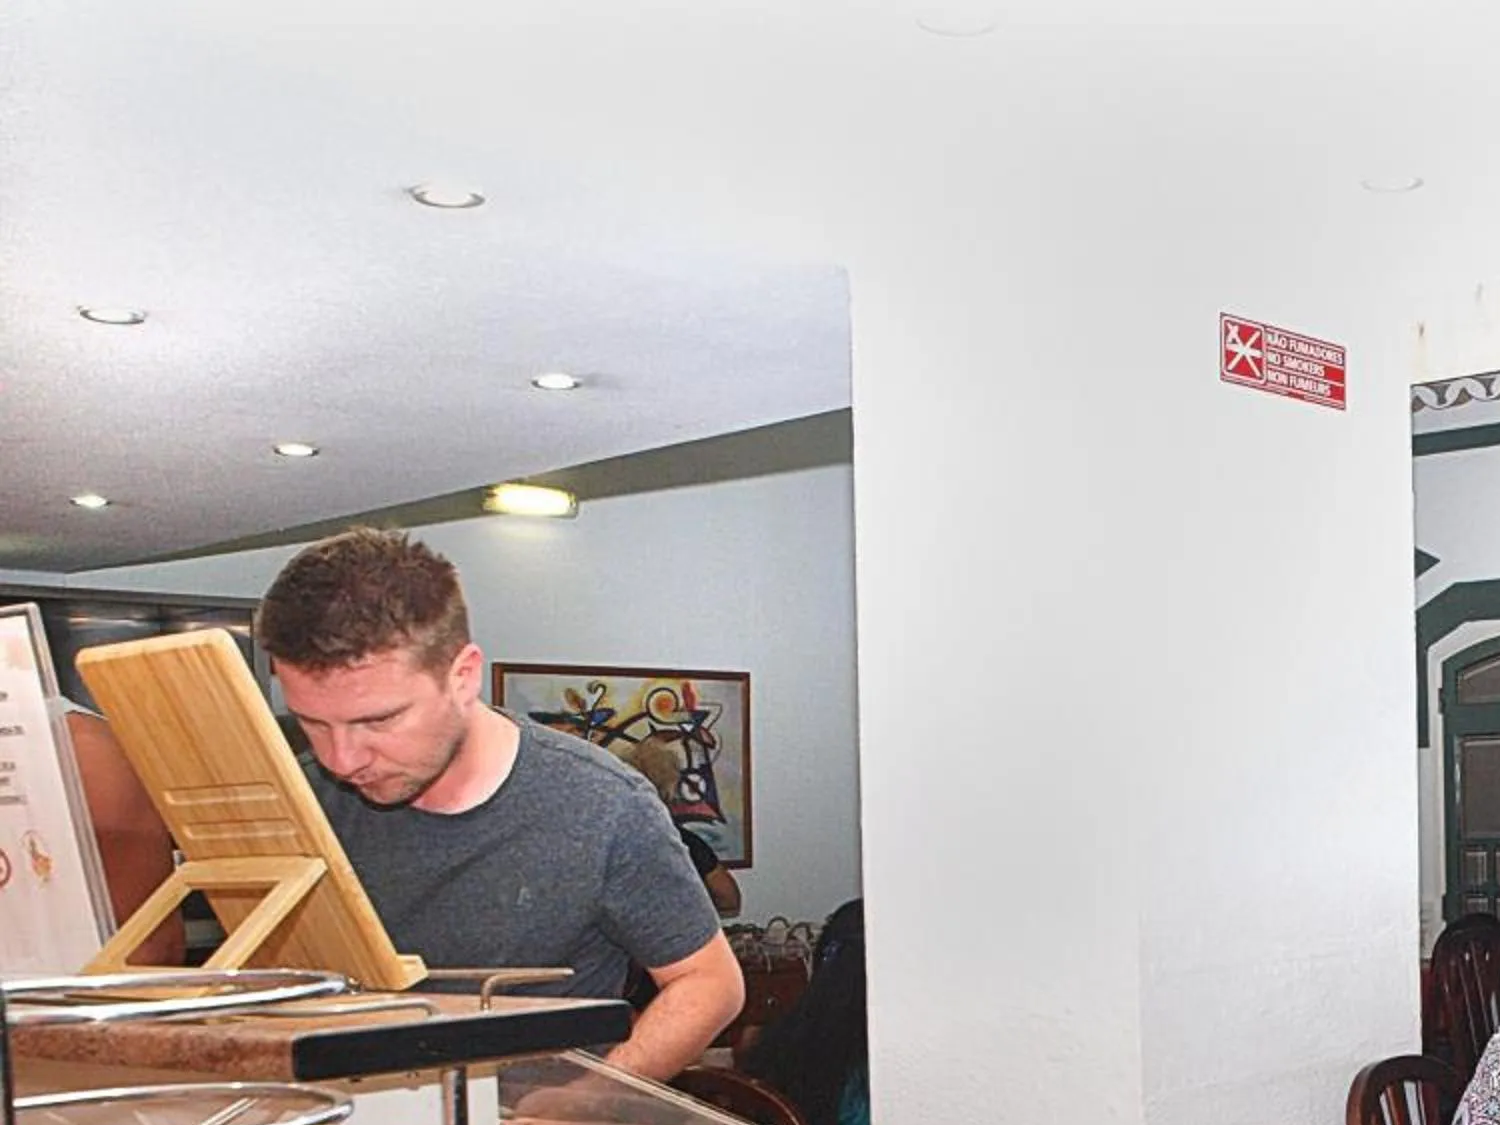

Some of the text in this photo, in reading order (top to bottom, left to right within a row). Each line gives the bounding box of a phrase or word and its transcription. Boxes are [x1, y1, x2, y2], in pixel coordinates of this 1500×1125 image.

[1266, 352, 1325, 377] NO SMOKERS
[1266, 370, 1331, 397] NON FUMEURS
